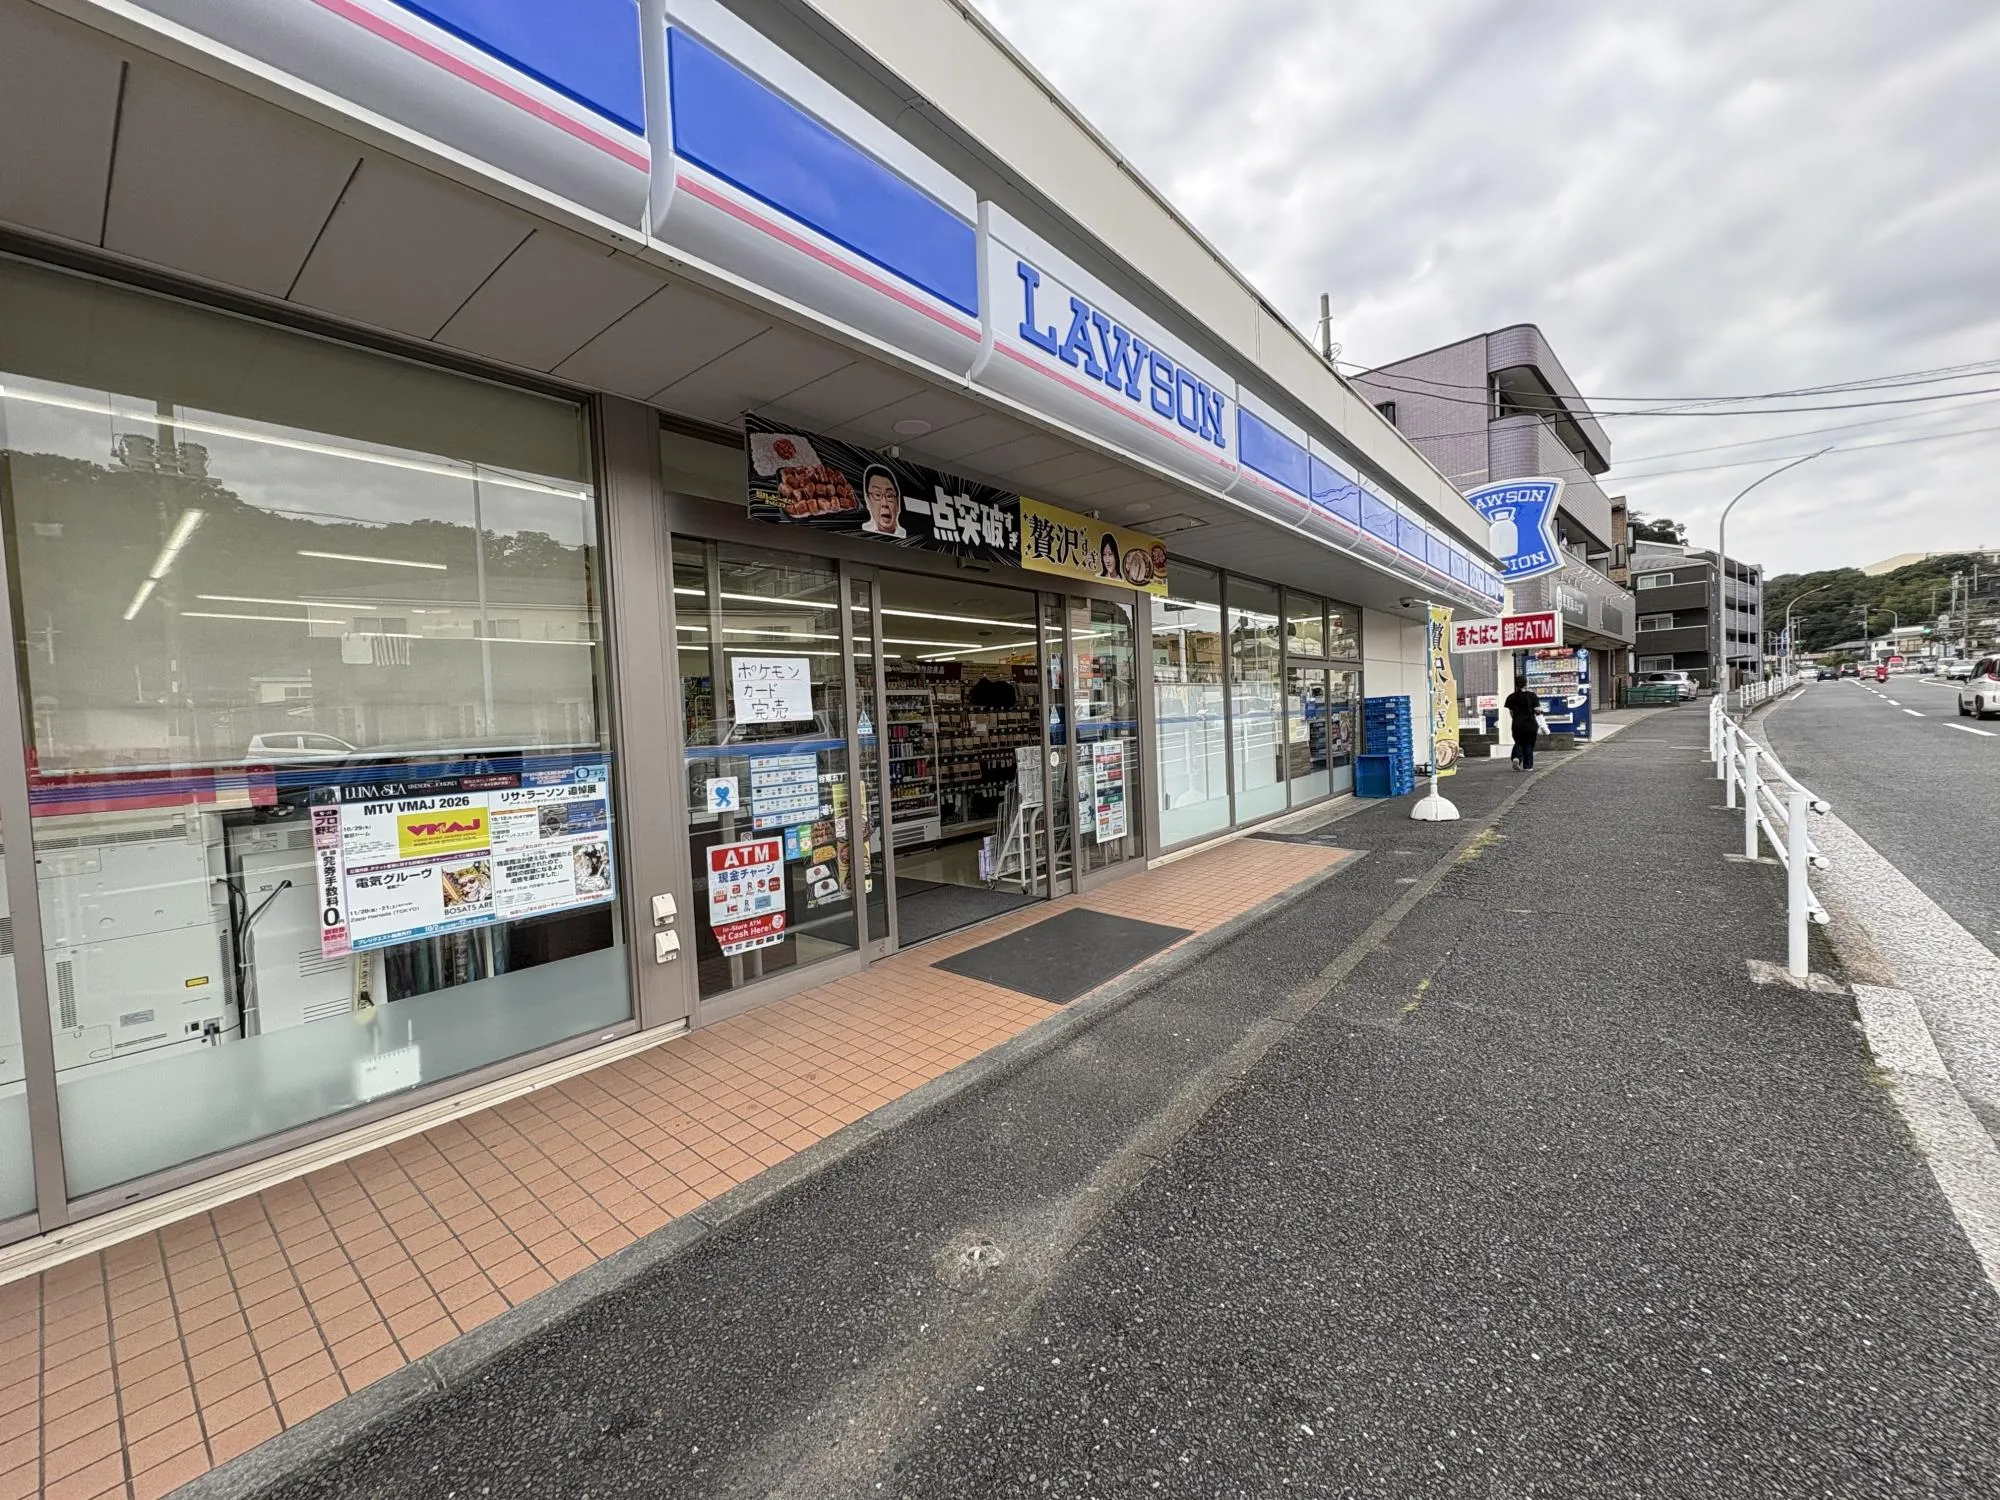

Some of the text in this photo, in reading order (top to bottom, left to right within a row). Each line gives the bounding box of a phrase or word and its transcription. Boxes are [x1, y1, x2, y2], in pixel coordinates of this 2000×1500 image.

[1017, 260, 1226, 449] LAWSON
[1475, 489, 1546, 510] AWSON
[1457, 619, 1553, 646] 酒・たばこ 銀行ATM
[738, 662, 800, 680] ポケモン
[744, 683, 778, 699] カード
[751, 698, 789, 720] 完売
[345, 785, 380, 799] LUNA
[381, 783, 407, 796] SEA
[501, 788, 565, 802] リサ・ラーソン
[568, 784, 597, 796] 追悼展
[364, 796, 470, 816] MTV VMAJ 2026
[724, 844, 770, 868] ATM
[323, 856, 339, 907] 発券手数料
[355, 868, 433, 889] 電気グルーヴ
[718, 863, 775, 883] 現金チャージ
[444, 902, 494, 916] BOSATS ARE
[723, 919, 762, 933] In-Store ATM
[728, 930, 749, 940] Cash
[750, 923, 772, 935] Here!
